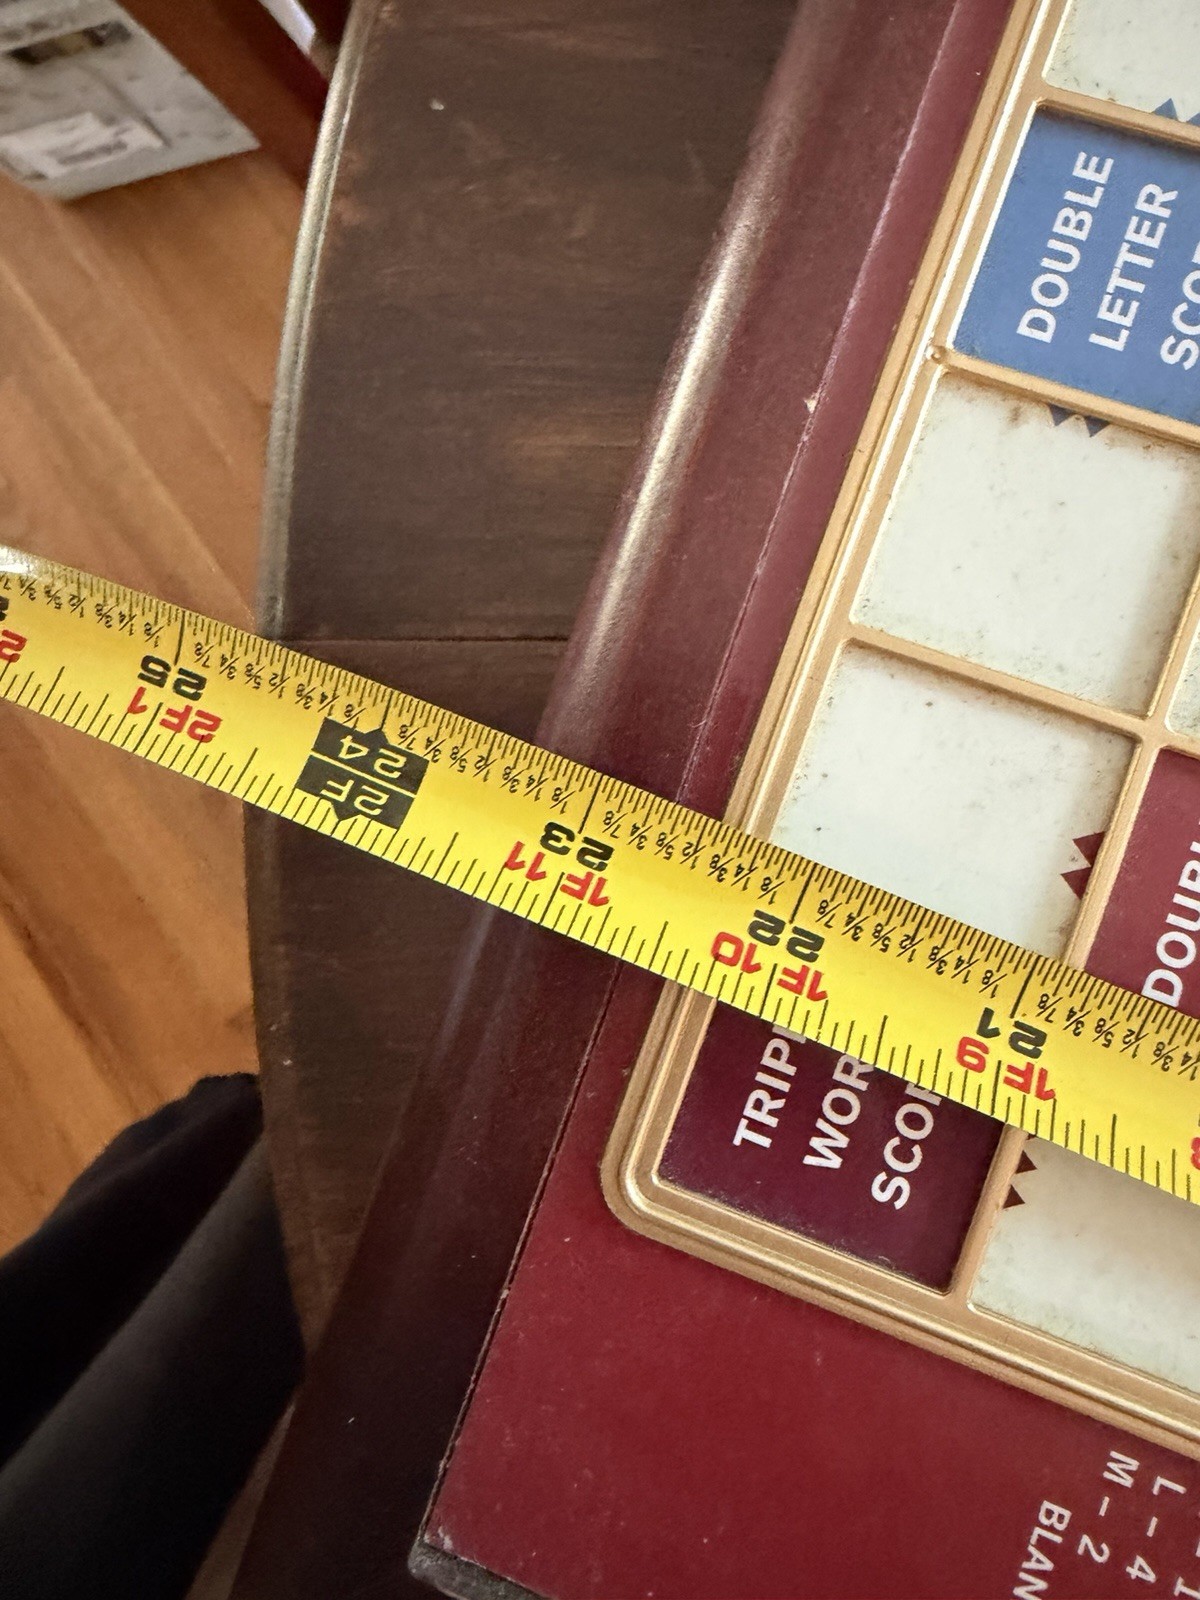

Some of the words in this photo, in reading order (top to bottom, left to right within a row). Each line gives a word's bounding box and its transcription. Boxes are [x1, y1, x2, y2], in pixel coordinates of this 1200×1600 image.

[1017, 152, 1114, 343] DOUBLE
[1089, 184, 1178, 351] LETTER
[138, 655, 207, 701] 25
[159, 704, 222, 743] 2F
[338, 735, 407, 778] 24
[320, 780, 389, 815] 2F
[504, 841, 546, 881] 11
[540, 822, 614, 871] 23
[561, 871, 608, 906] 1F
[710, 931, 761, 973] 10
[749, 910, 824, 962] 22
[778, 964, 826, 1001] 1F
[977, 1008, 1047, 1058] 21
[956, 1036, 989, 1073] 9
[1003, 1062, 1055, 1101] 1F
[1103, 1451, 1140, 1488] M
[1152, 1476, 1187, 1495] L
[1077, 1535, 1110, 1563] 2
[1126, 1555, 1157, 1583] 4
